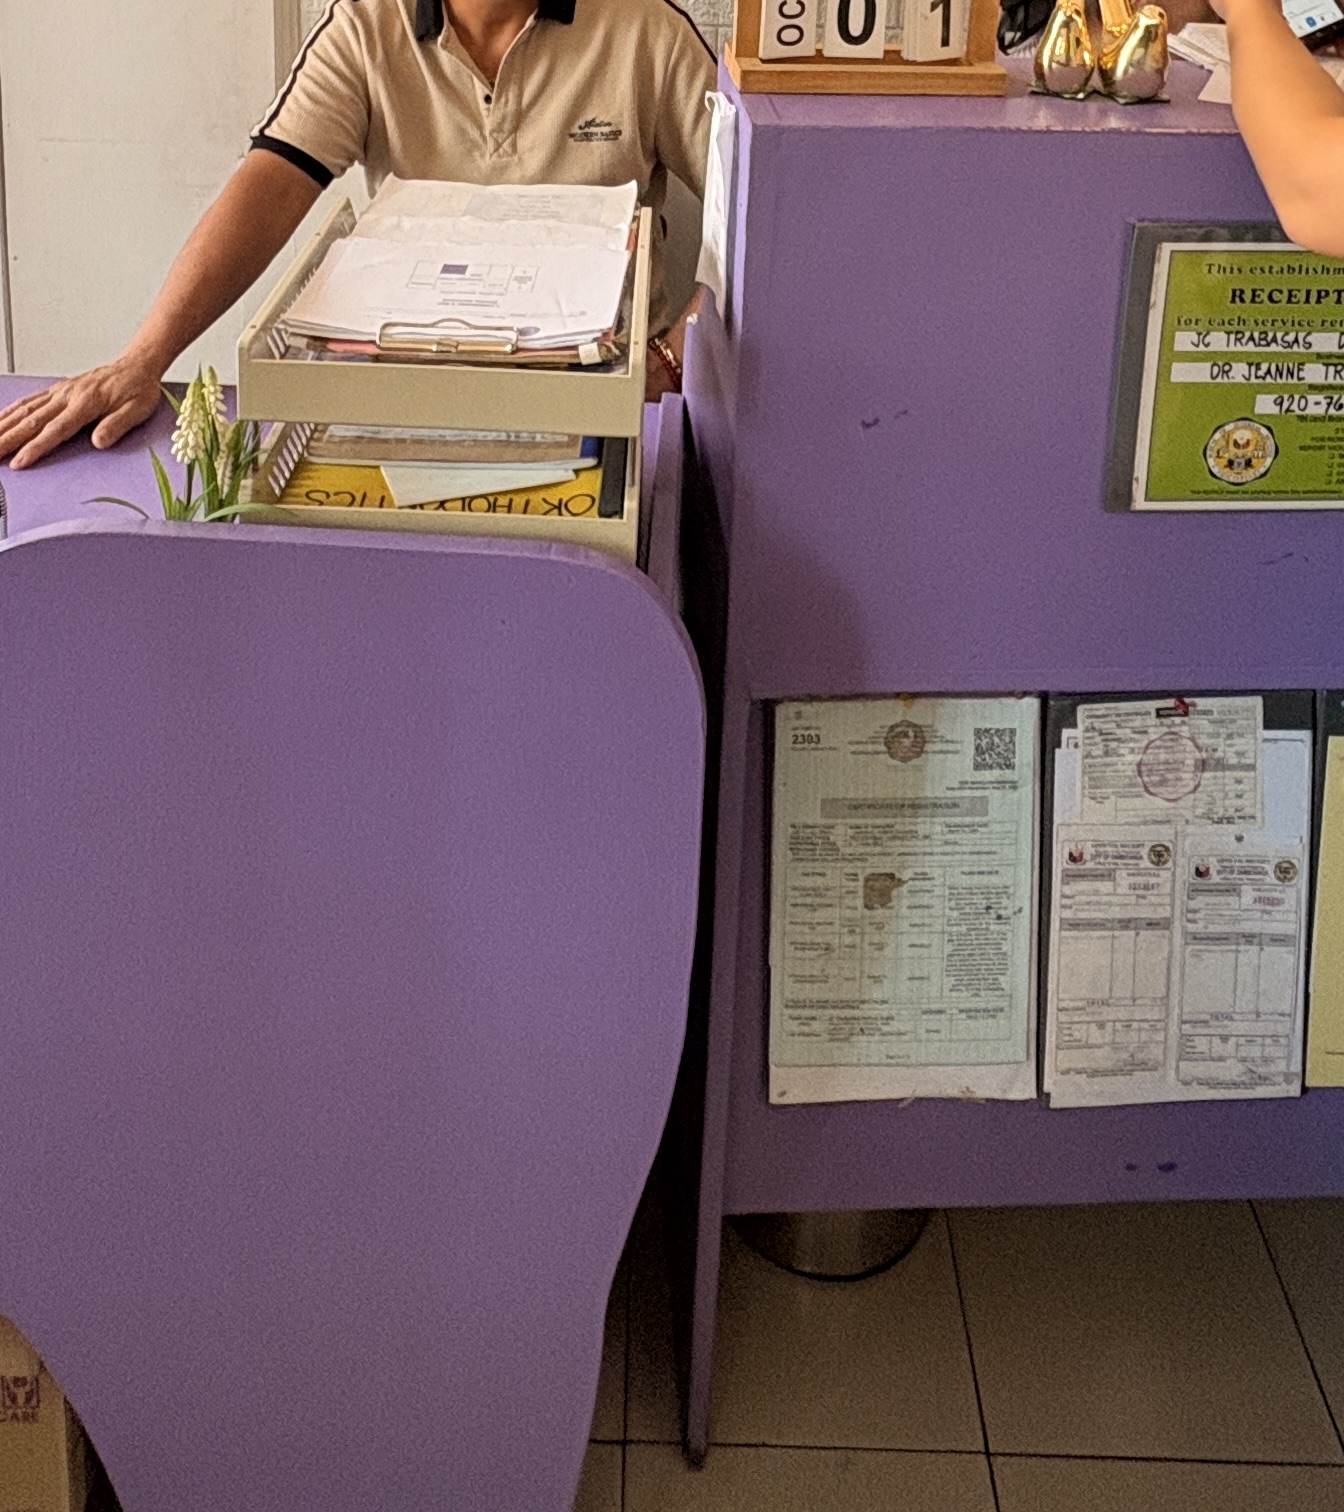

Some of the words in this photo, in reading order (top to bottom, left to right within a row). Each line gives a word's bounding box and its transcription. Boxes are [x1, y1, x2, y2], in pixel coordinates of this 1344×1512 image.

[1205, 263, 1243, 275] This
[1177, 316, 1202, 327] for
[1208, 315, 1247, 327] each
[1254, 315, 1316, 327] service
[1190, 331, 1212, 349] JC
[1224, 331, 1313, 350] TRABASAS
[1210, 362, 1235, 380] DR.
[1242, 361, 1306, 381] JEANNE
[791, 734, 822, 745] 2303
